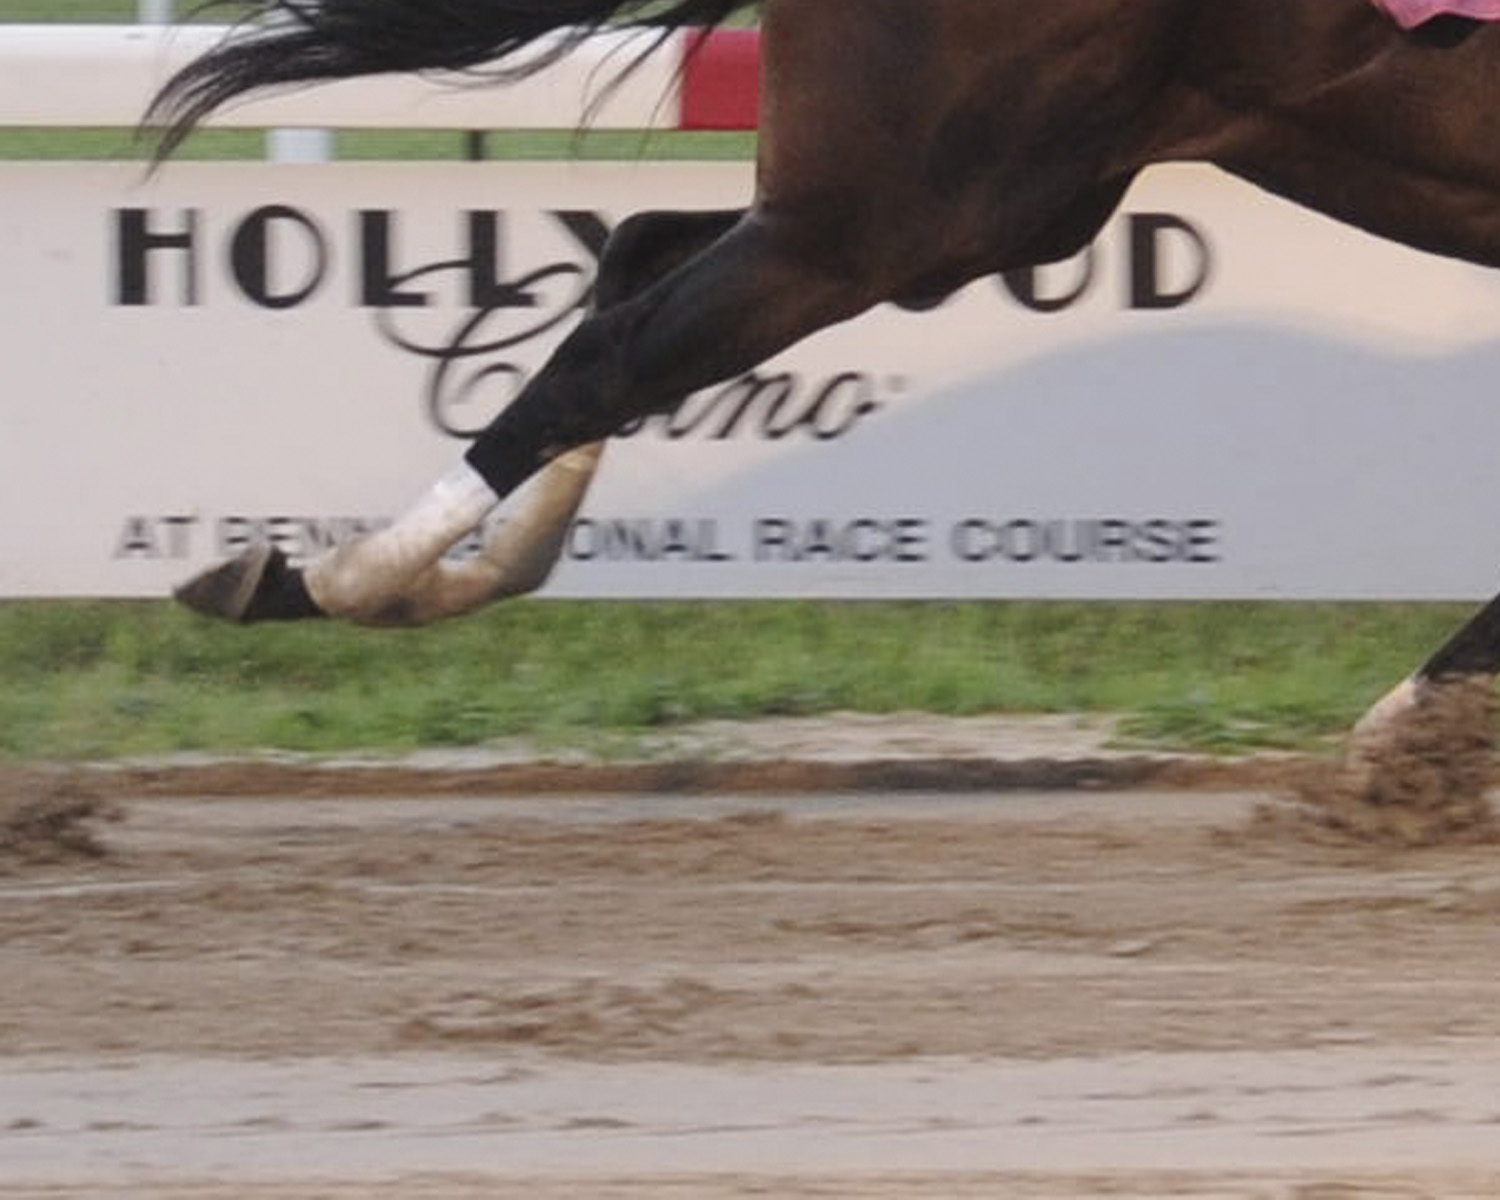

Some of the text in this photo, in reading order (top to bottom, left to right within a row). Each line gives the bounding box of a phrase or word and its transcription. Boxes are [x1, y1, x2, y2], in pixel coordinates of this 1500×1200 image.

[112, 203, 1214, 314] HOLLOD
[112, 516, 197, 560] AT
[753, 518, 928, 563] RACE
[949, 518, 1222, 564] COURSE
